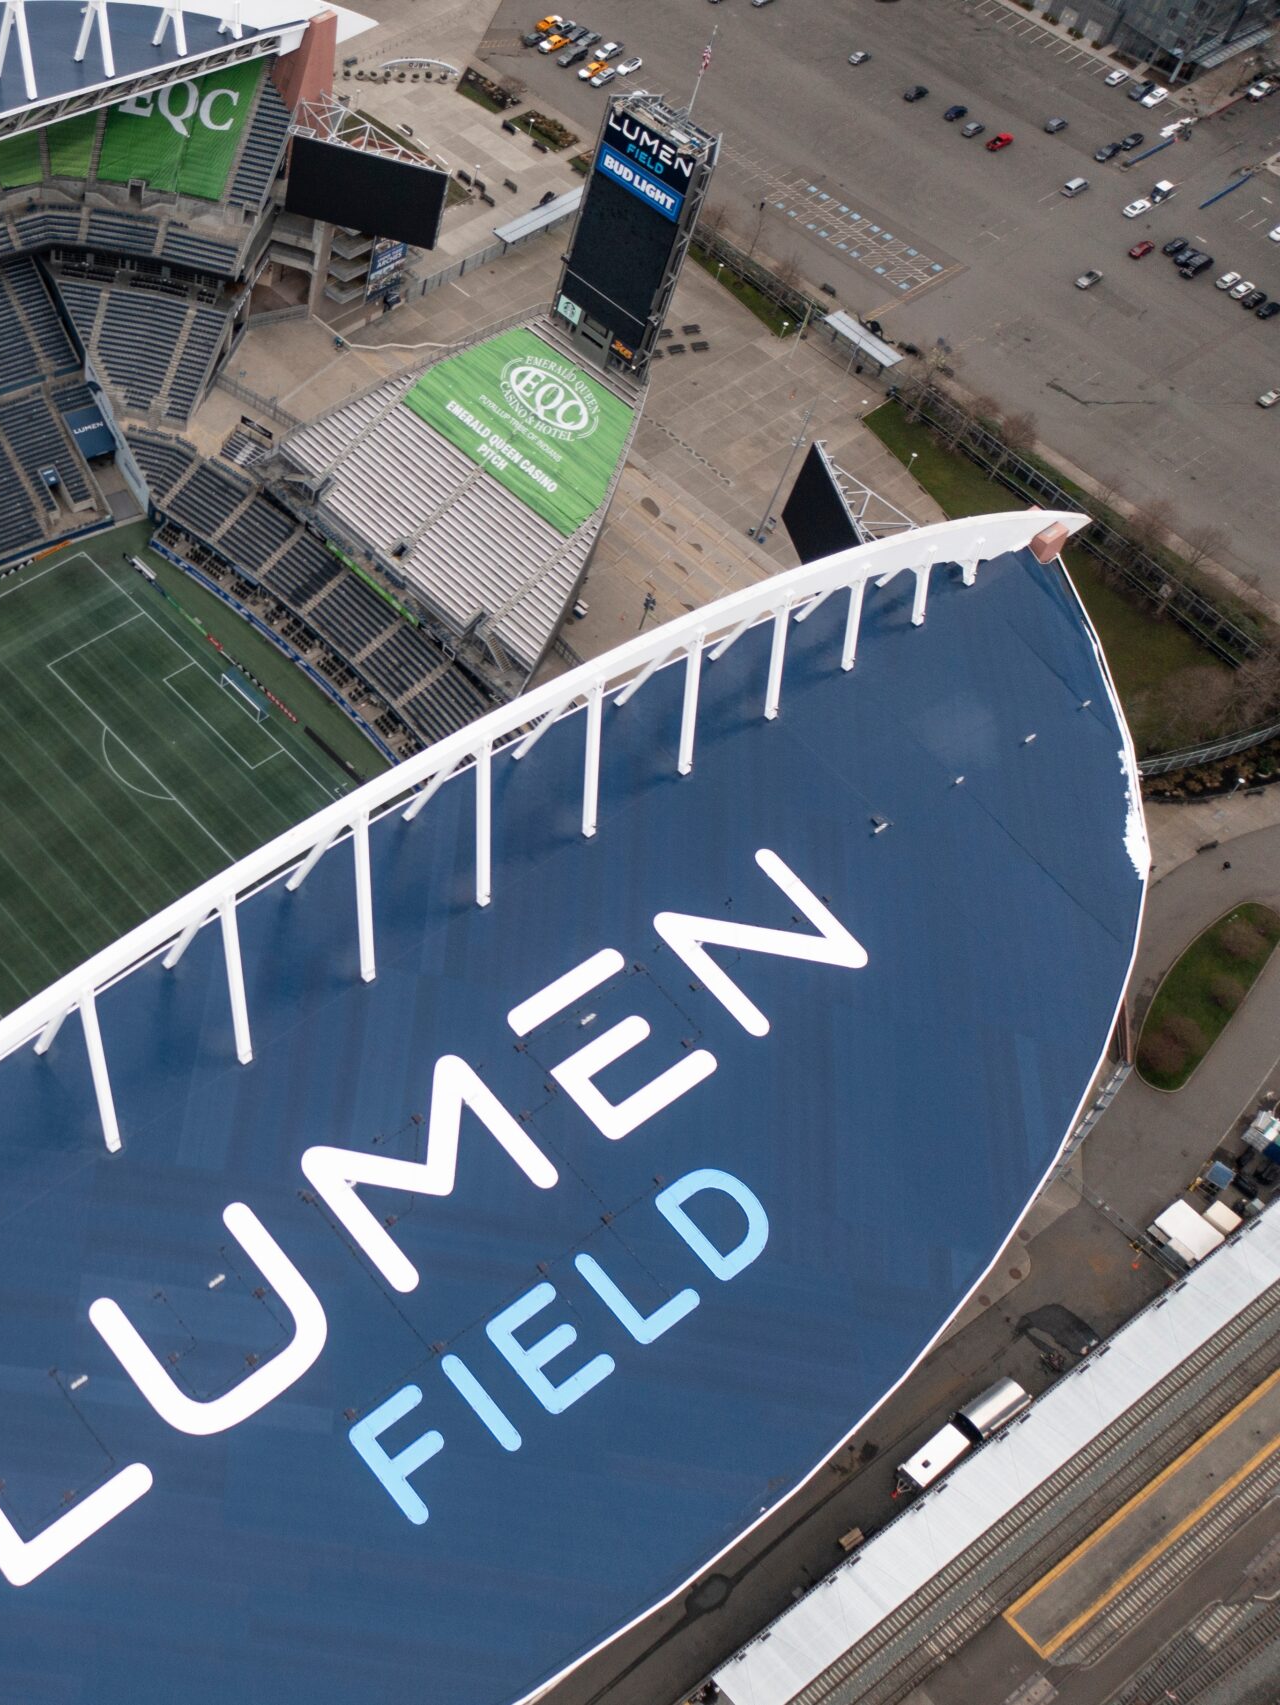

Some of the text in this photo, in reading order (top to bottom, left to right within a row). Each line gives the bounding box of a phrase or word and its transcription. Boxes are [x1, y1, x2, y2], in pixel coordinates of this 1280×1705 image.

[608, 111, 694, 178] LUMEN
[626, 143, 665, 175] FIELD
[603, 154, 676, 210] BUD LIGHT
[500, 380, 528, 418] CASINO
[533, 420, 576, 442] HOTEL
[517, 368, 586, 429] EQC
[525, 355, 601, 415] EMERALD QUEEN
[73, 421, 104, 435] LUMEN
[445, 400, 559, 493] EMERALD QUEEN CASINO
[476, 443, 509, 471] PITCH
[347, 1167, 771, 1527] FIELD
